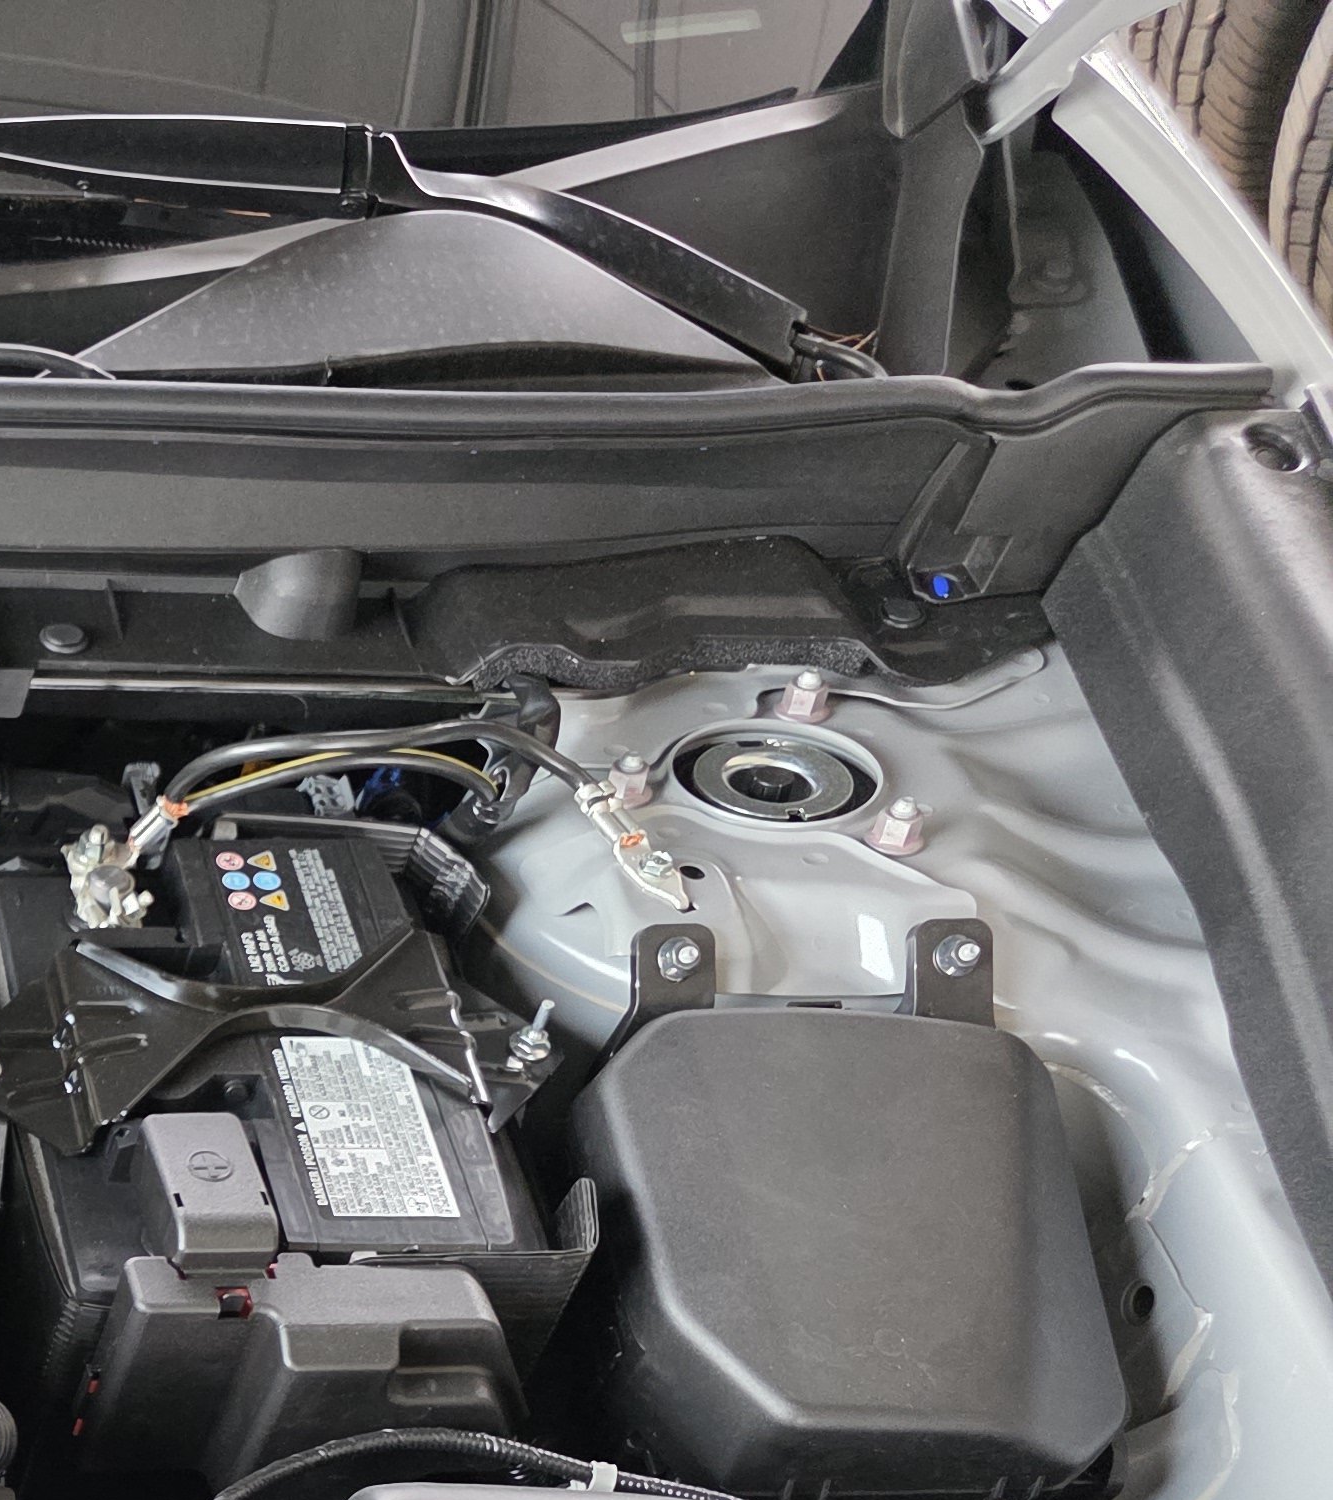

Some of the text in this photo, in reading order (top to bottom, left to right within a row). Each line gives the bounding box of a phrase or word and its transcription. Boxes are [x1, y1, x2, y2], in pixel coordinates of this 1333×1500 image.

[282, 1085, 301, 1117] PELIGRO
[296, 1134, 316, 1165] POISON
[307, 1170, 328, 1205] DANGER
